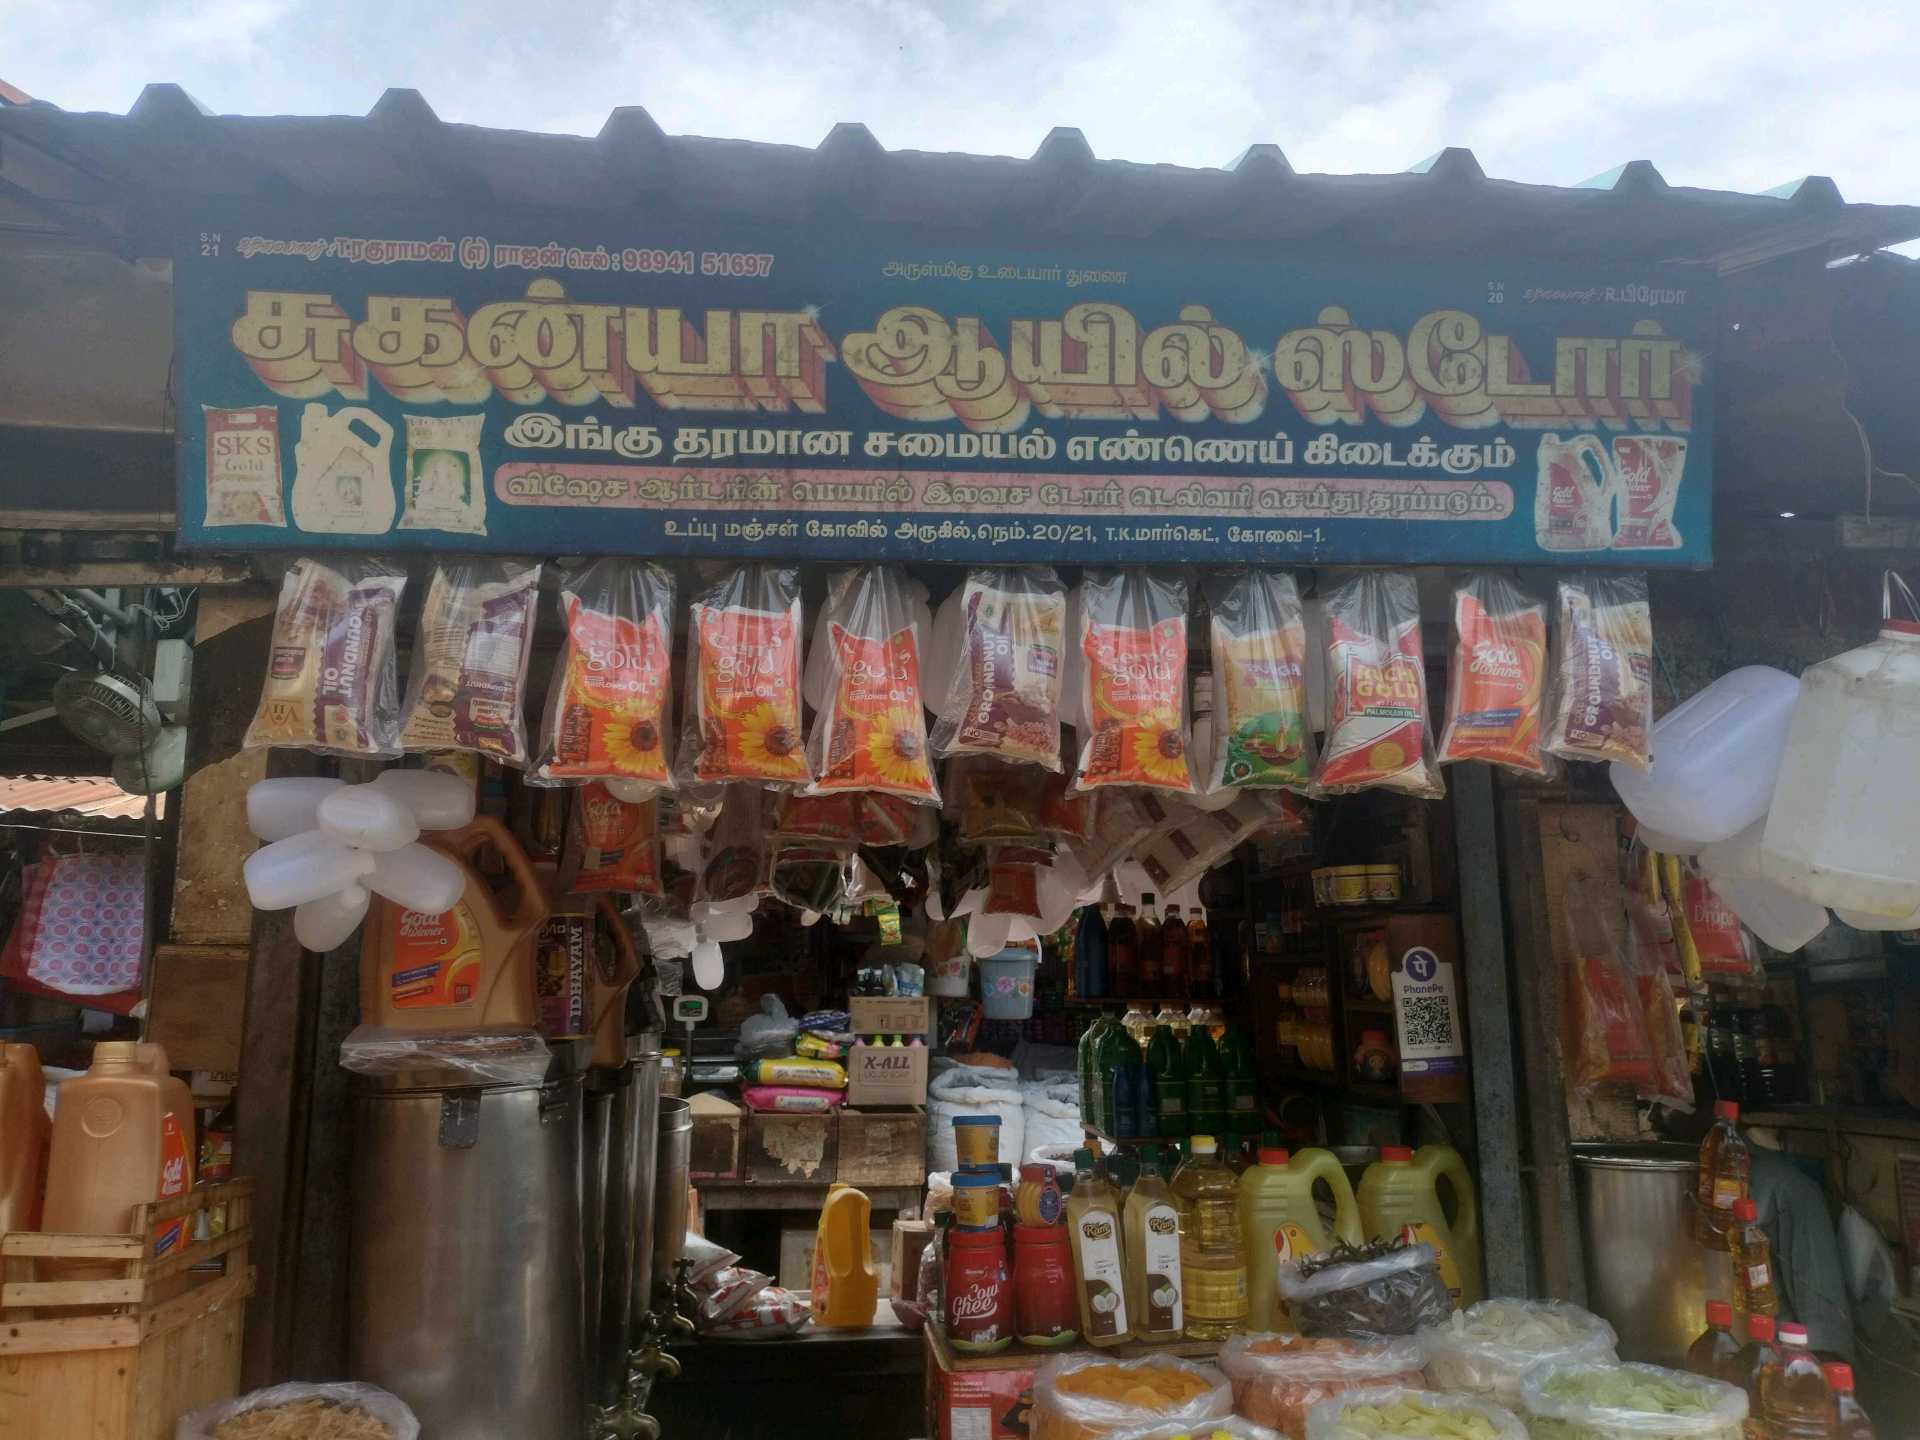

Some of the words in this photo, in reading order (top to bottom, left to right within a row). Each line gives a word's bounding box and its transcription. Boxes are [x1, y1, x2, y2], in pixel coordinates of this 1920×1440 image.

[202, 244, 220, 257] 21
[494, 242, 565, 269] ராஜன்
[622, 249, 695, 277] 98941
[700, 253, 776, 278] 51697
[882, 259, 976, 282] அருள்மிகு
[1487, 291, 1505, 304] 20
[232, 279, 824, 400] சுகன்யா
[841, 303, 1257, 420] ஆயில்
[1274, 306, 1692, 416] ஸ்டோர்
[216, 436, 272, 457] SKS
[504, 413, 663, 460] இங்கு
[673, 424, 853, 463] தரமான
[864, 428, 1056, 460] சமையல்
[1066, 429, 1293, 465] எண்ணெய்
[1303, 433, 1516, 475] கிடைக்கும்
[225, 456, 265, 473] Gold
[791, 478, 914, 505] பெயரில்
[921, 481, 1032, 507] இலவச
[1039, 480, 1123, 508] டோர்
[1129, 482, 1254, 510] டெலிவரி
[1259, 485, 1361, 516] செய்து
[664, 516, 718, 542] உப்பு
[724, 517, 800, 543] மஞ்சள்
[806, 518, 889, 541] கோவில்
[1357, 681, 1419, 699] GOLD
[570, 926, 584, 1017] IDHAYAM
[1402, 984, 1444, 995] PhonePe
[864, 1055, 911, 1071] X-ALL
[967, 1281, 999, 1303] Cow
[952, 1296, 998, 1327] Ghee
